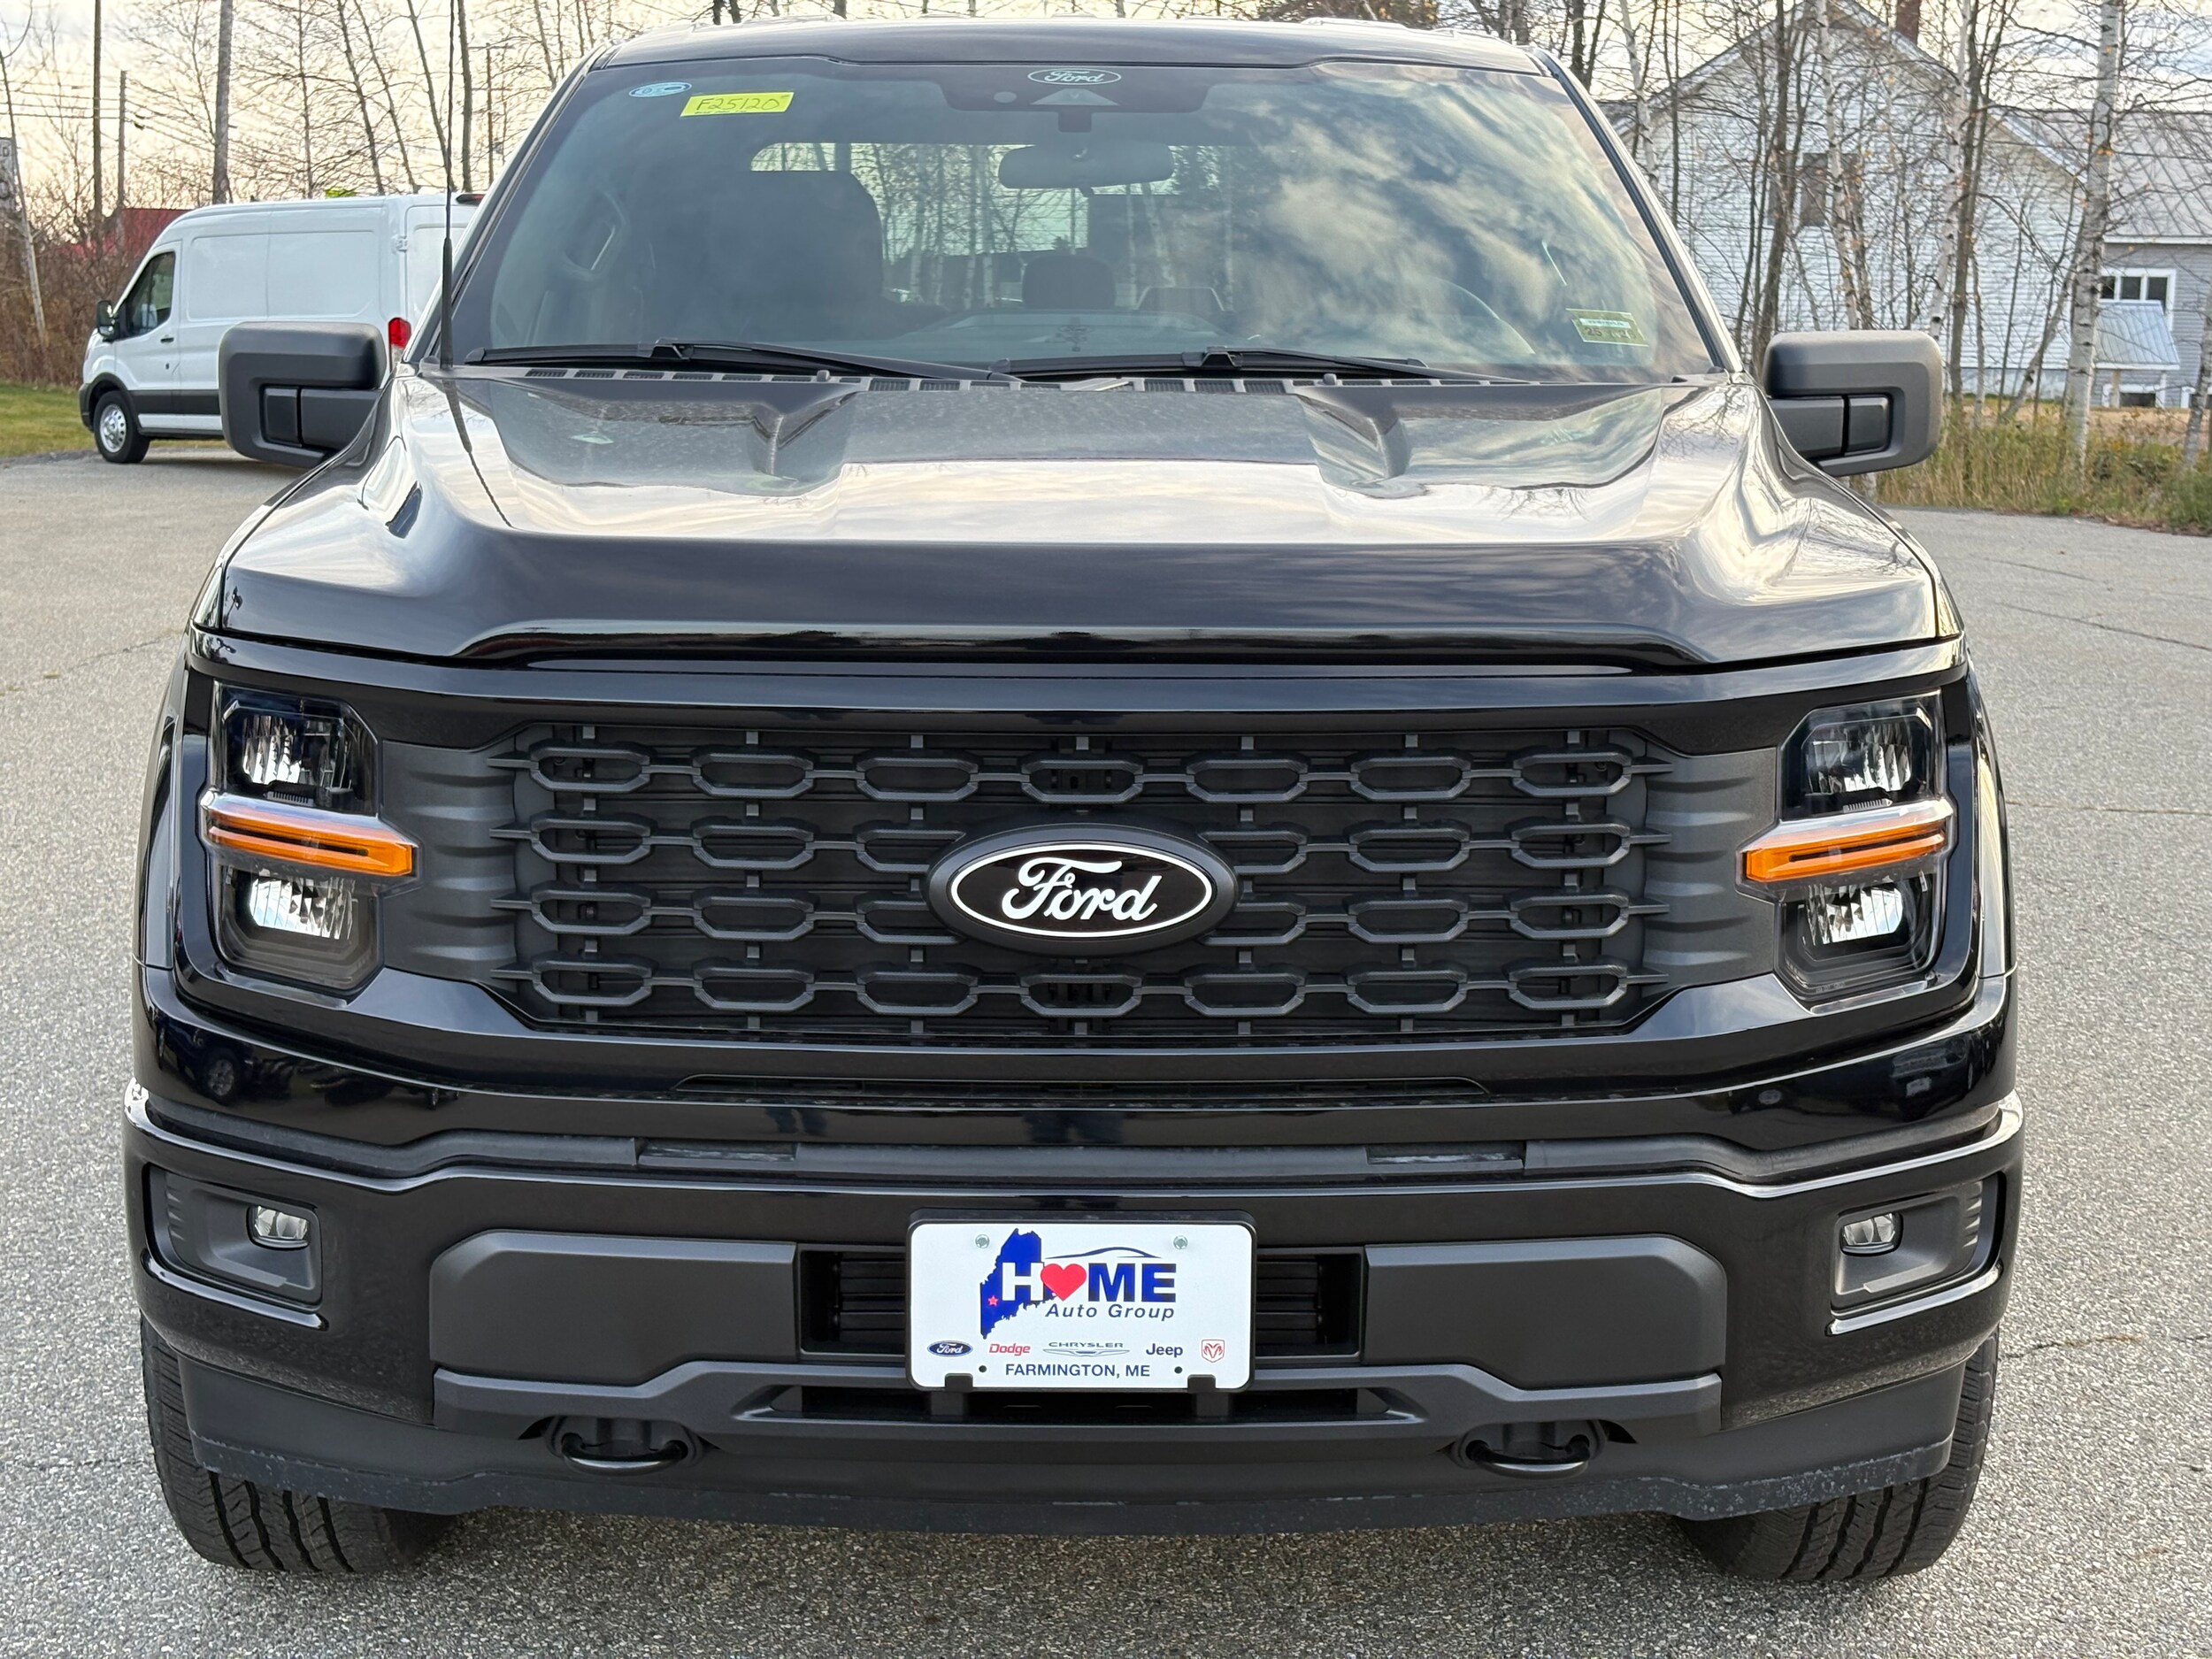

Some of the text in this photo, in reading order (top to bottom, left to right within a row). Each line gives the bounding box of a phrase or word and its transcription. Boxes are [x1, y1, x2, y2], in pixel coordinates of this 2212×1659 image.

[1044, 70, 1105, 82] Ford
[696, 97, 780, 111] F25120
[1002, 856, 1162, 921] Ford
[1045, 1303, 1175, 1322] Auto Group
[935, 1341, 964, 1356] Ford
[988, 1342, 1031, 1356] Dodge
[1146, 1342, 1184, 1358] Jeep
[1005, 1363, 1150, 1379] FARMINGTON, ME
